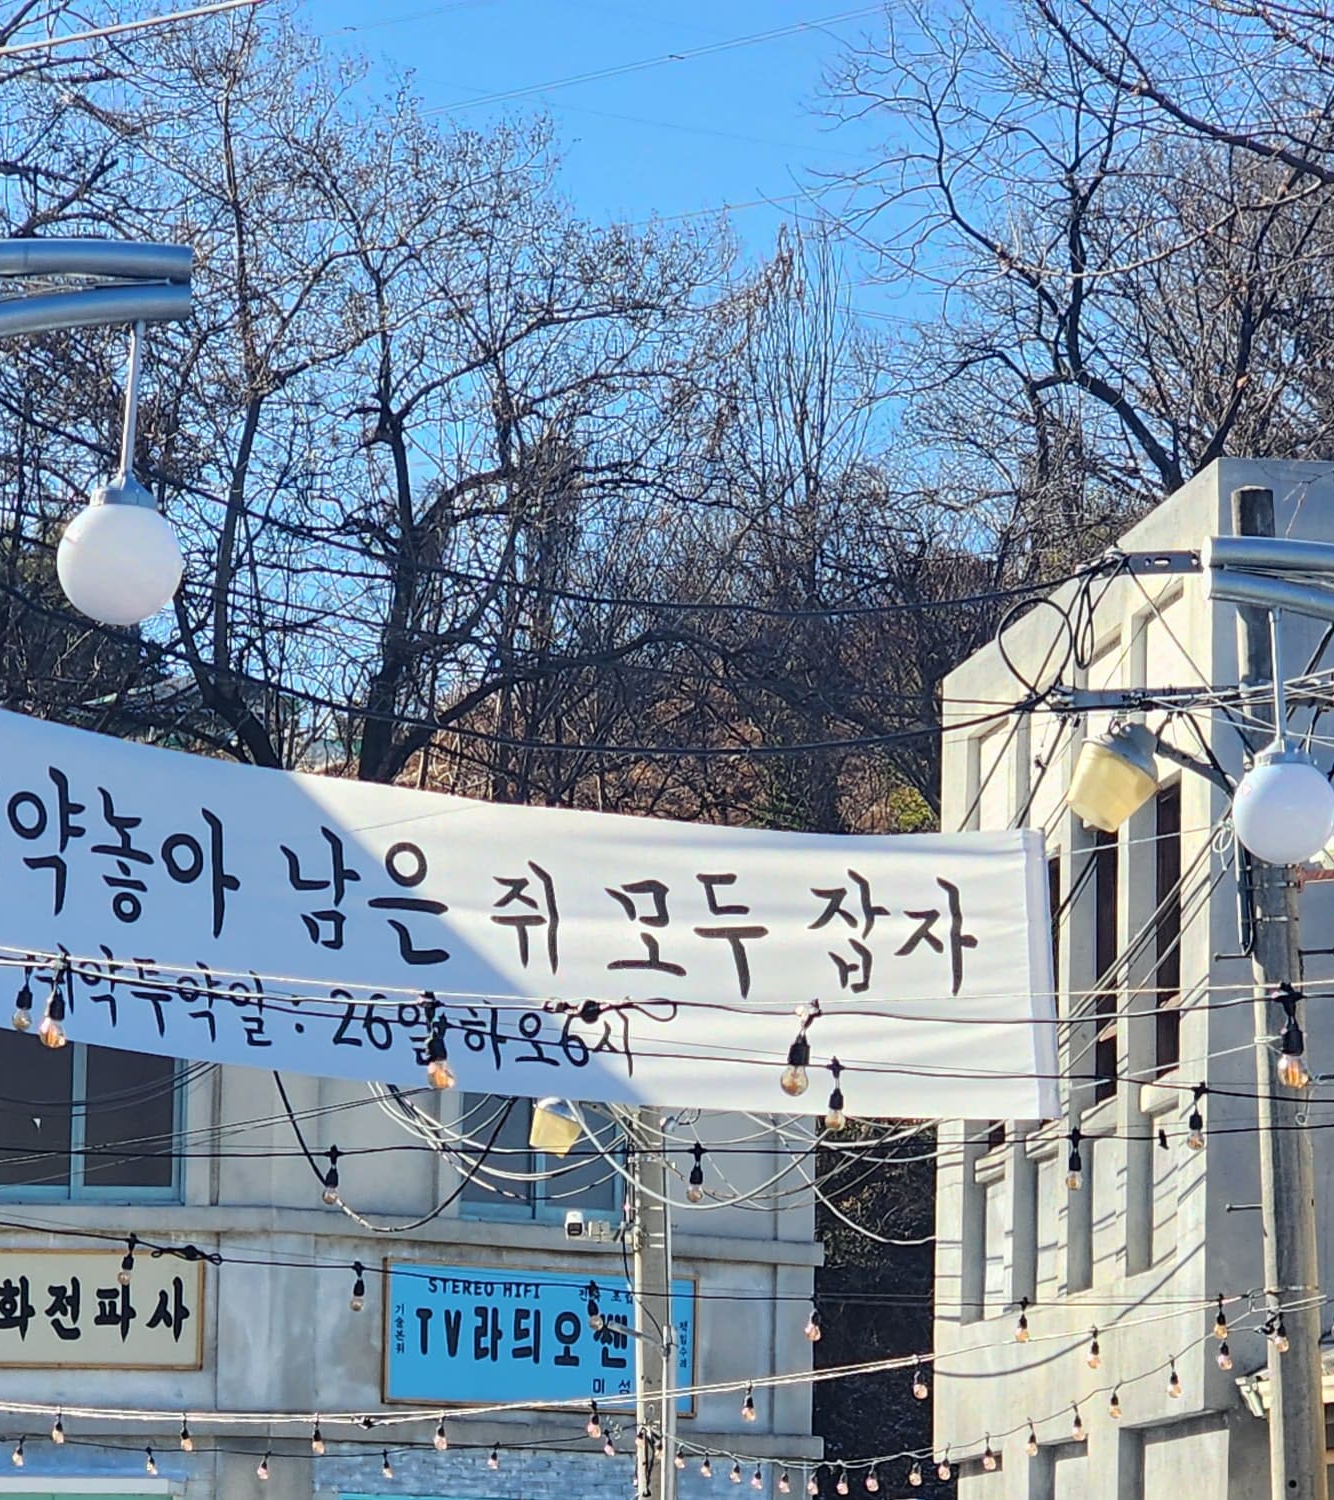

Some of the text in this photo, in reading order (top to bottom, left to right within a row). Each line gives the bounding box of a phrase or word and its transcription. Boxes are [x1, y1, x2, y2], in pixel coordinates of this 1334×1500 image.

[279, 824, 450, 966] 남은
[490, 859, 560, 975] 쥐
[604, 872, 769, 1000] 모두
[807, 868, 979, 997] 잡자
[428, 1276, 541, 1299] STEREO HIFI
